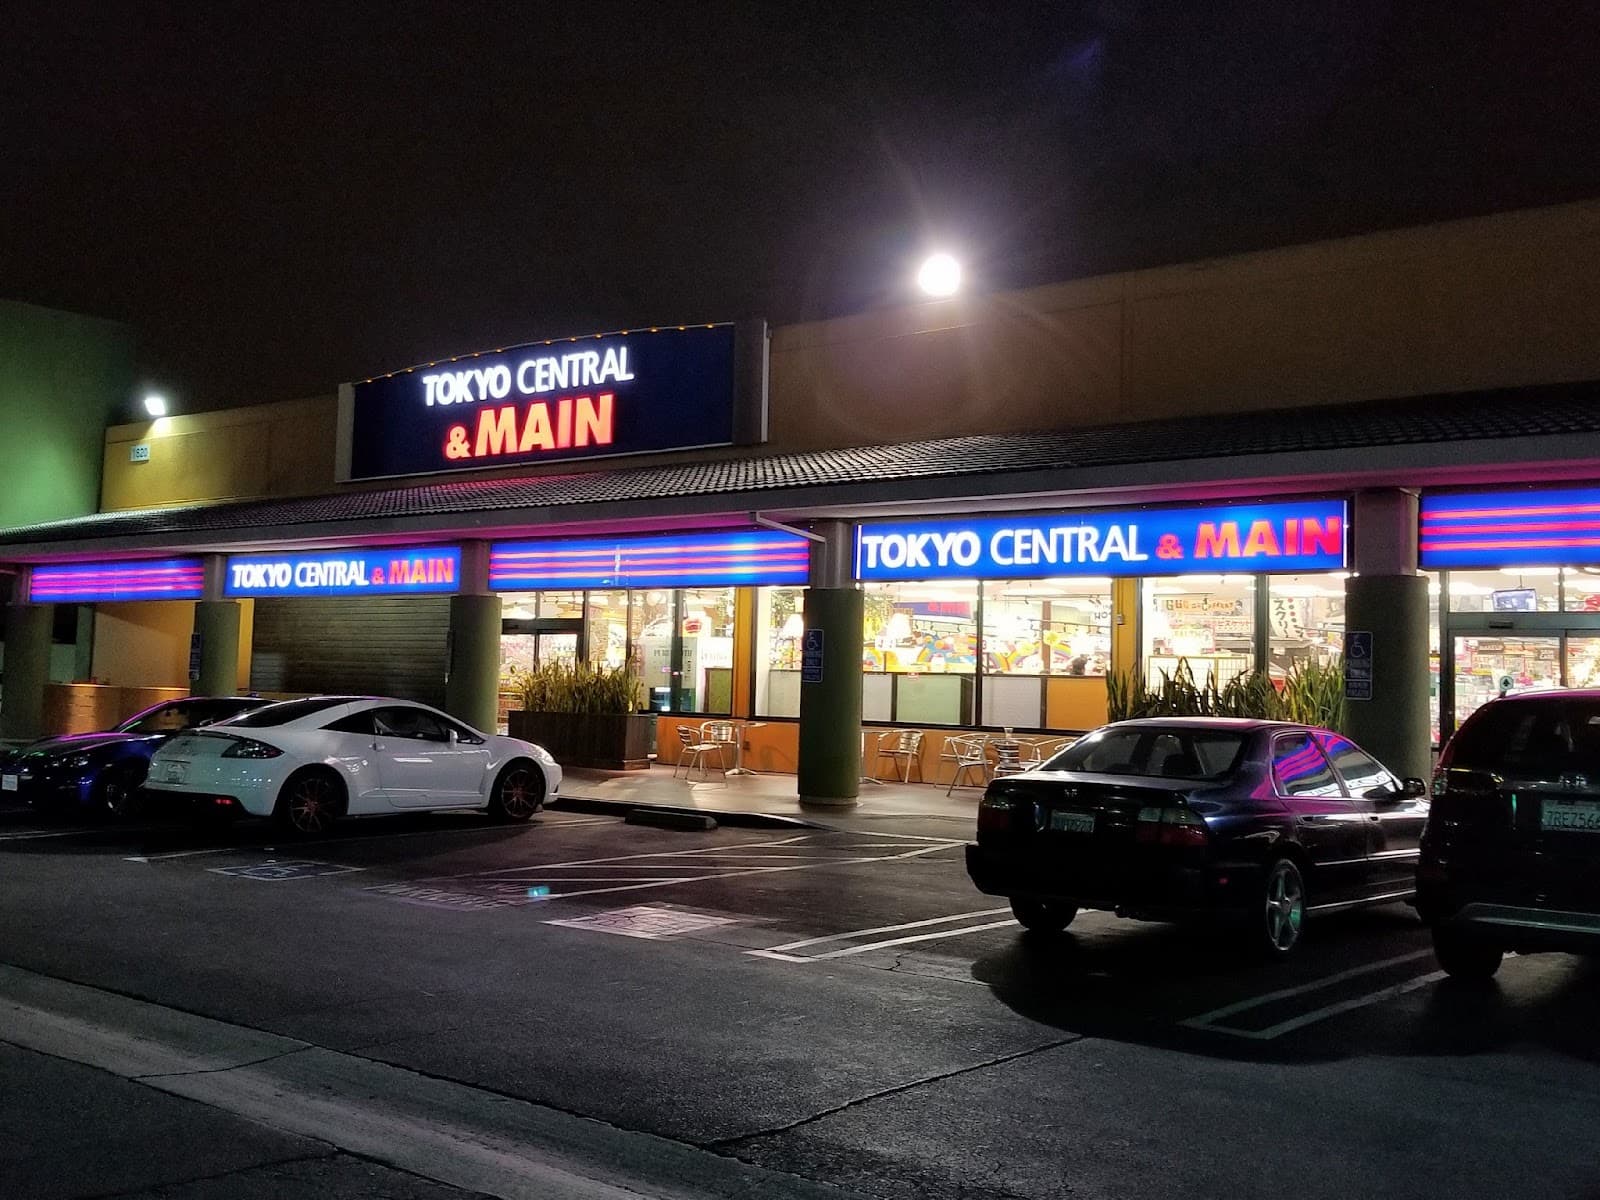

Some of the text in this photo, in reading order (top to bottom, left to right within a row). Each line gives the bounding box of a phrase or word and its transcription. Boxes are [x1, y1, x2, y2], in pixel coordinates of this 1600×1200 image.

[422, 346, 635, 407] TOKYO CENTRAL
[862, 516, 1342, 569] TOKYO CENTRAL & MAIN
[231, 557, 454, 588] TOKYO CENTRAL & MAIN
